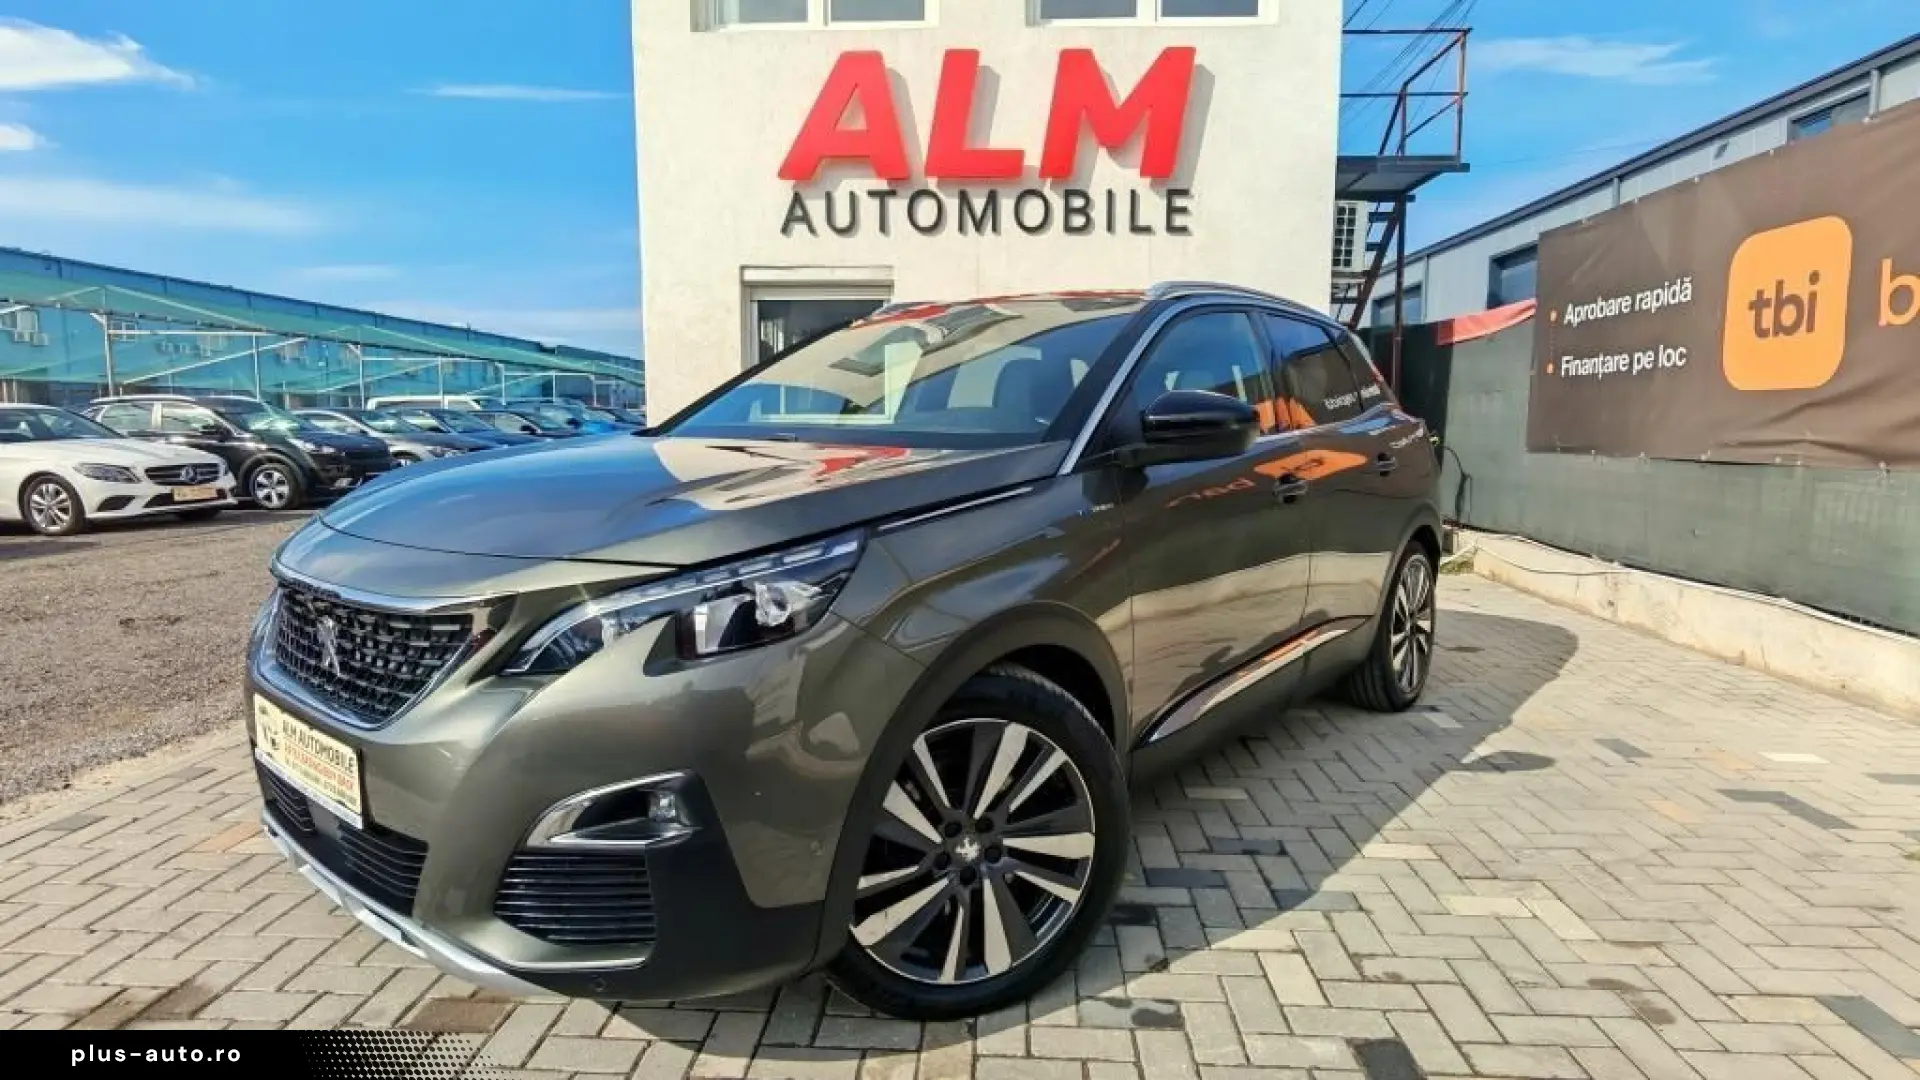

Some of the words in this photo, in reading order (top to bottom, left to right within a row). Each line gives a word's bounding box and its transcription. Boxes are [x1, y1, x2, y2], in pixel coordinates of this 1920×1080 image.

[778, 46, 1196, 180] ALM
[780, 188, 1192, 236] AUTOMOBILE
[1563, 294, 1632, 326] Aprobare
[1634, 275, 1693, 314] rapidă
[1747, 269, 1820, 339] tbi
[1560, 350, 1630, 380] Finanțare
[1632, 350, 1654, 375] pe
[1657, 344, 1687, 368] loc
